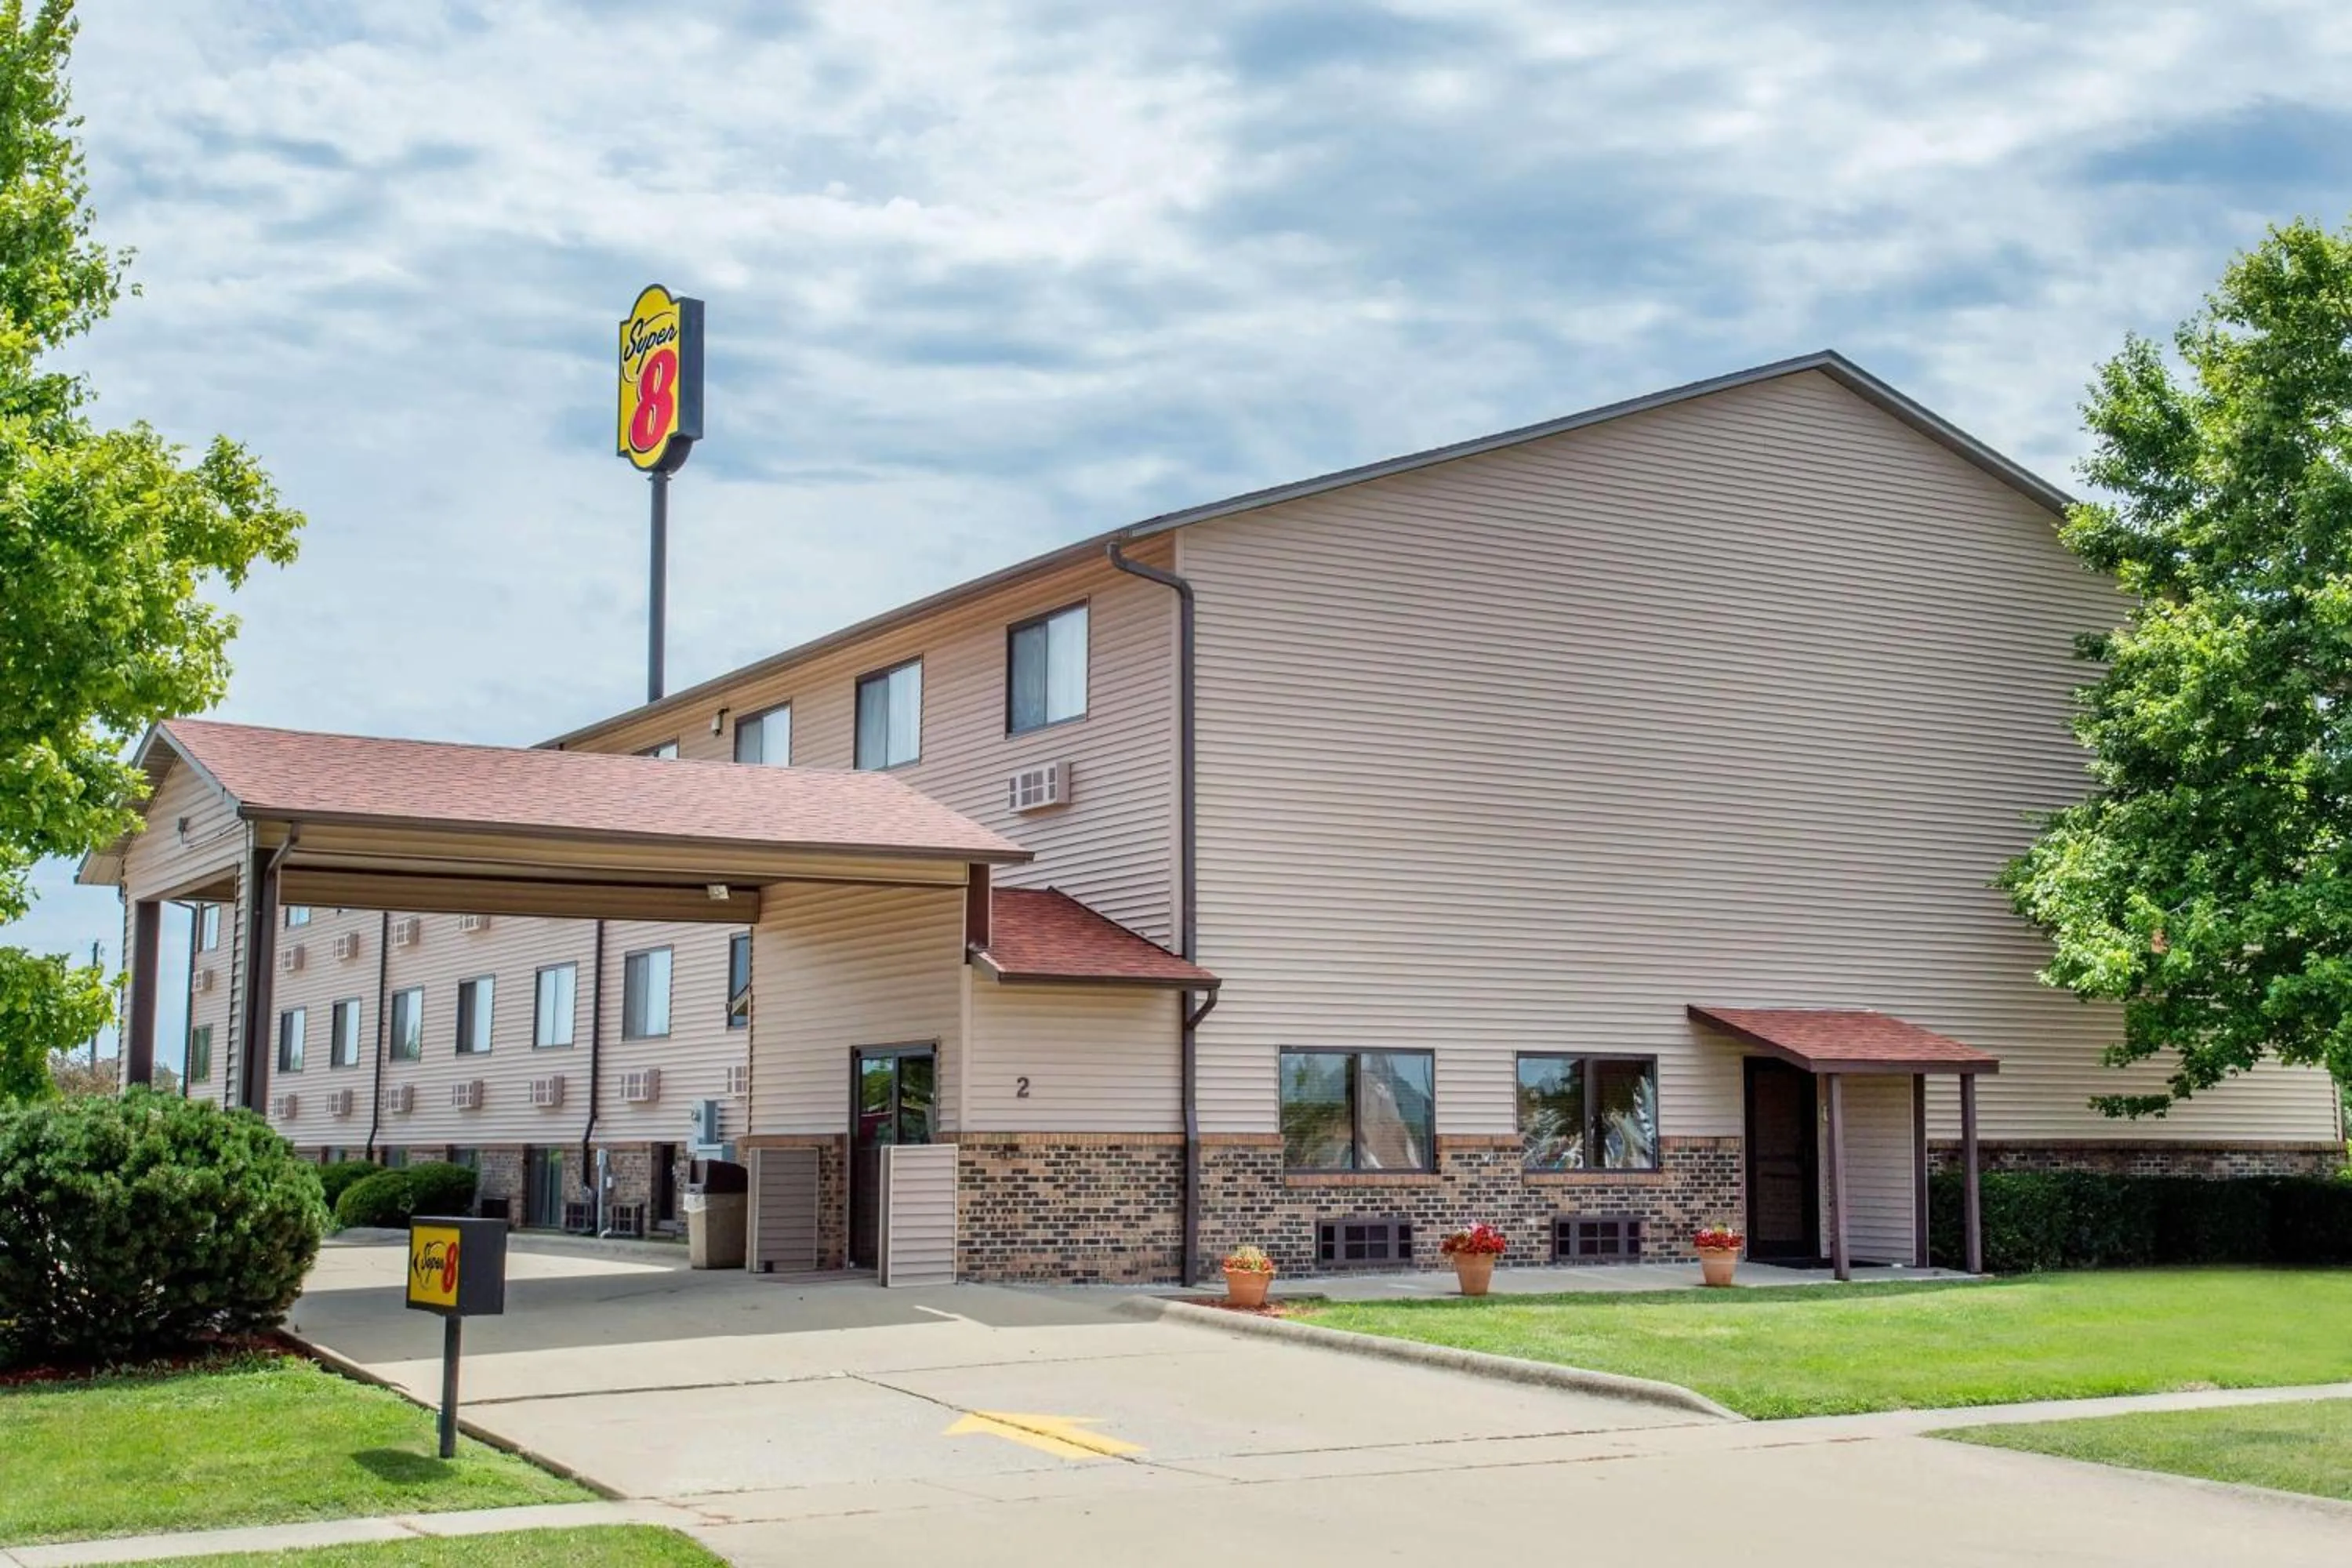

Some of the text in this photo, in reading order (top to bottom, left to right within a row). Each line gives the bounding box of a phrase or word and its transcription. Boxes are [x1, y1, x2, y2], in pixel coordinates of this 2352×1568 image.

[624, 317, 677, 375] Super
[629, 349, 677, 453] 8
[1017, 1076, 1029, 1098] 2
[441, 1241, 458, 1294] 8
